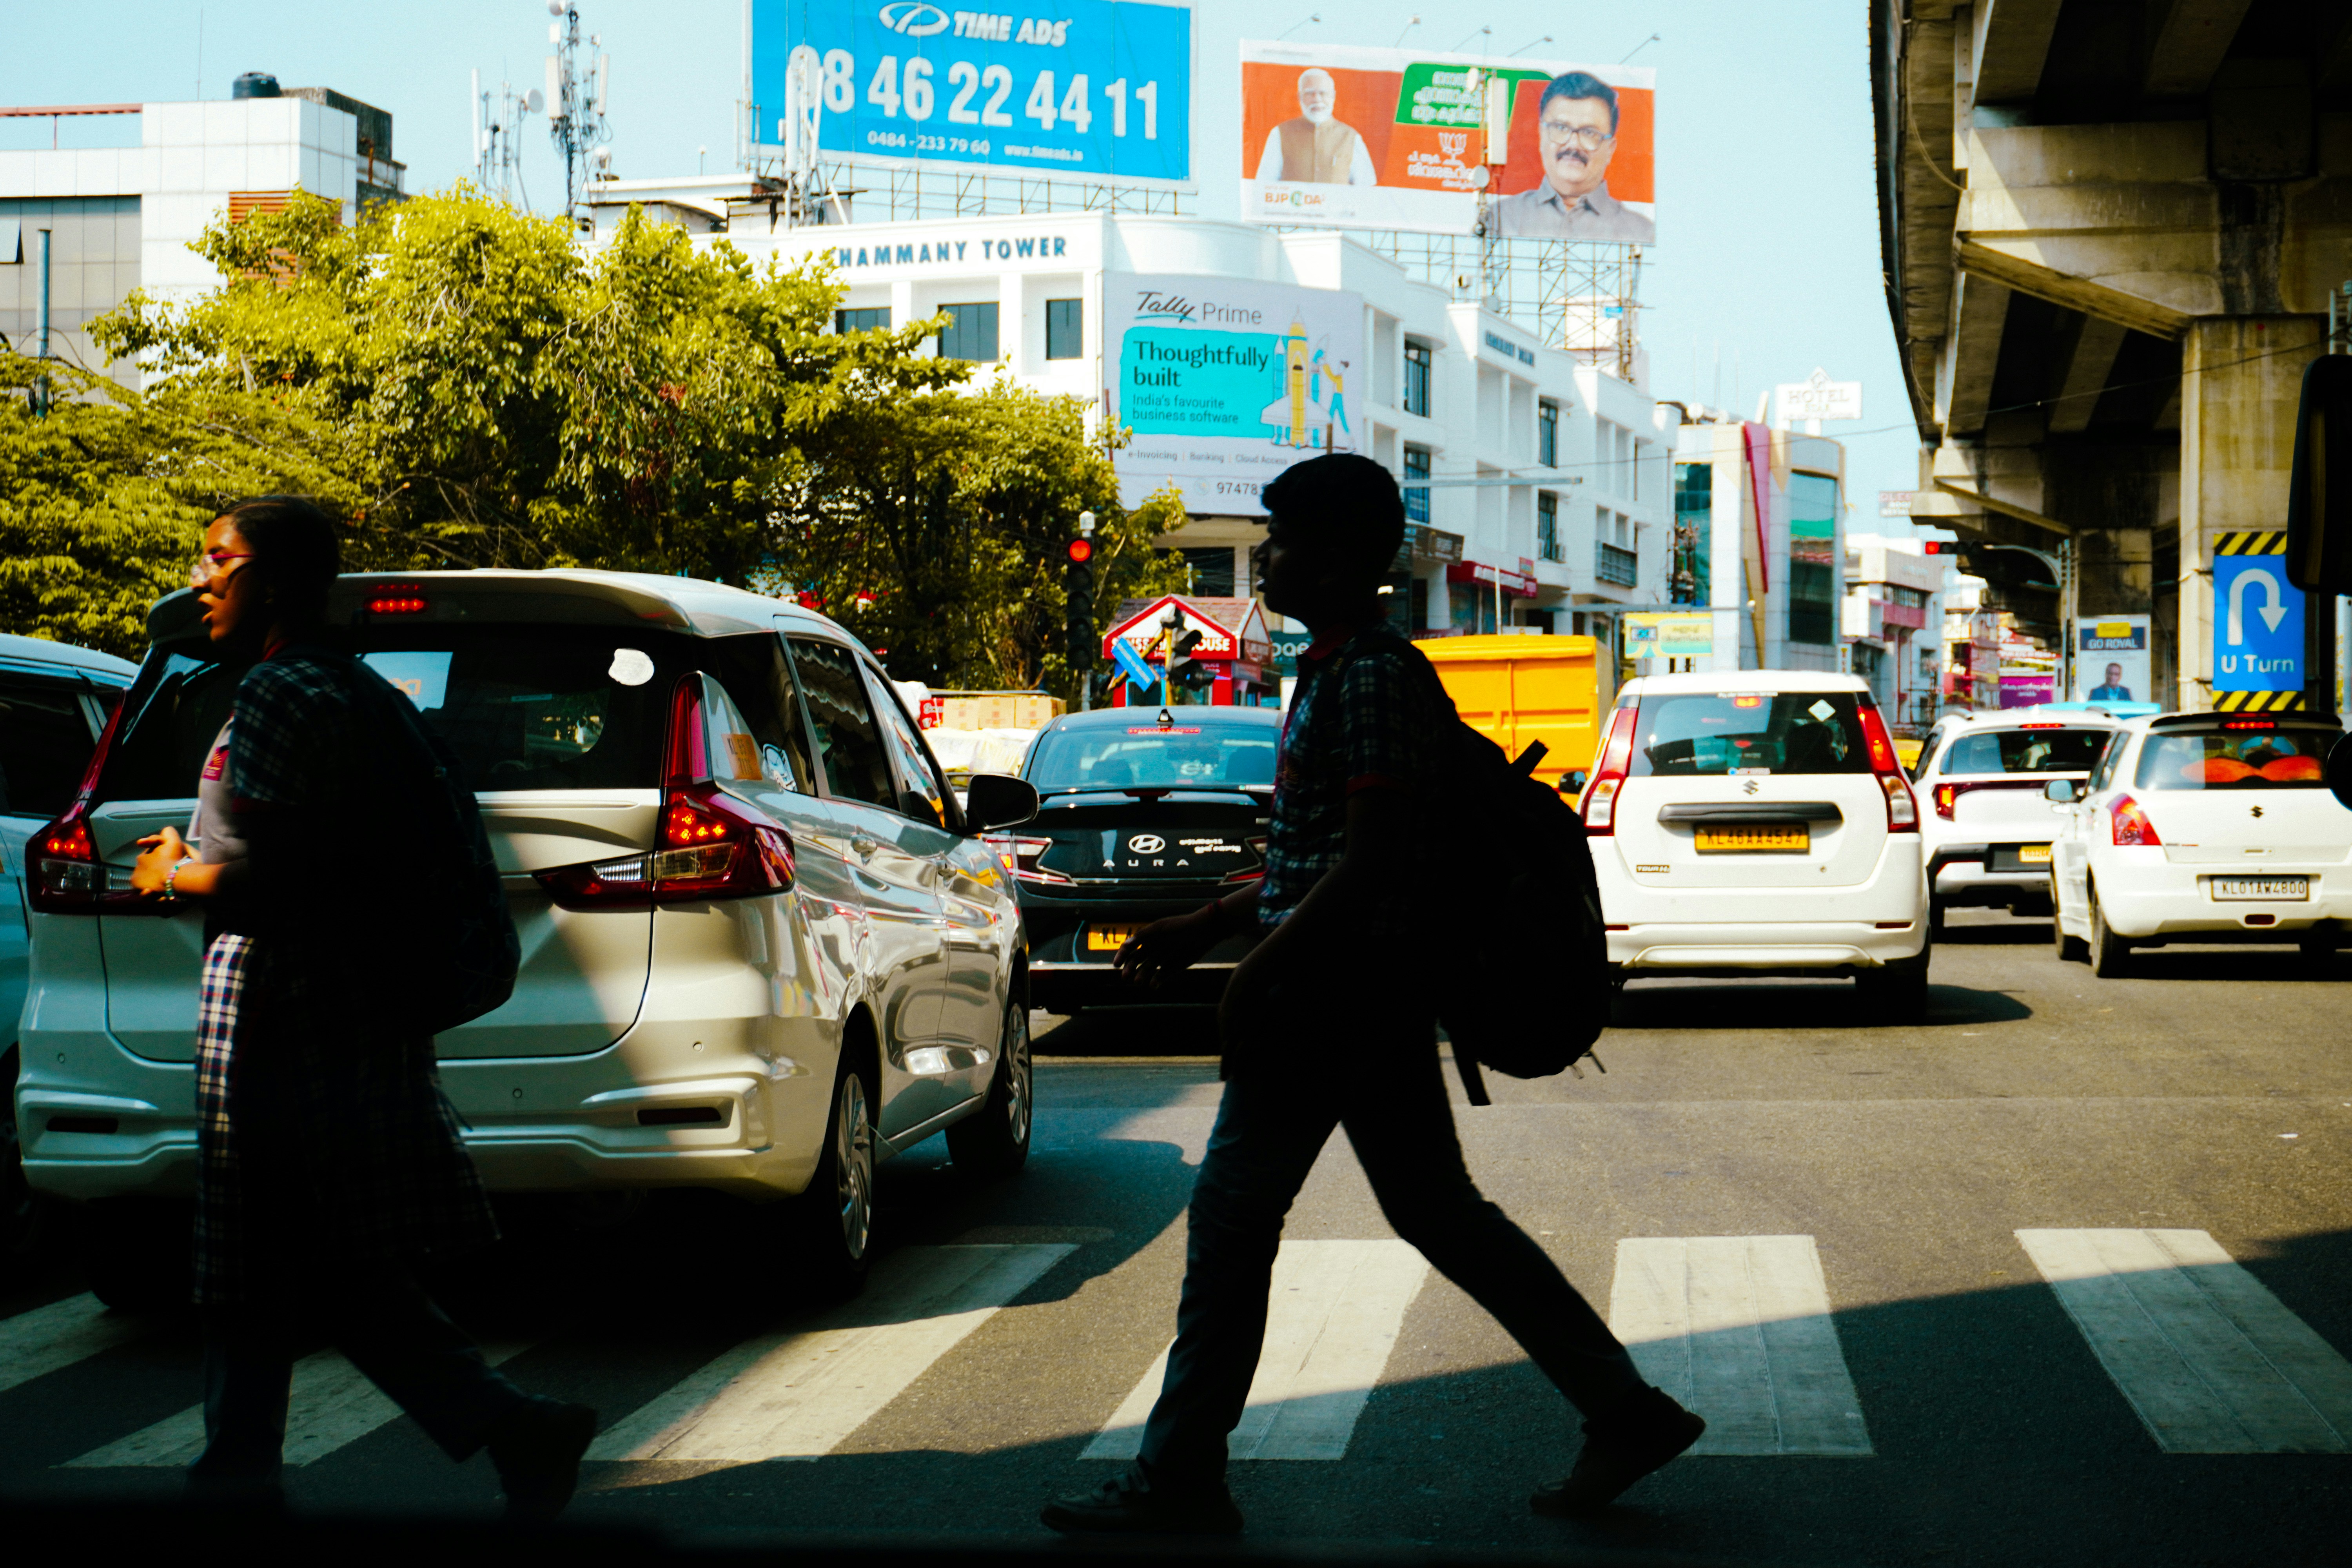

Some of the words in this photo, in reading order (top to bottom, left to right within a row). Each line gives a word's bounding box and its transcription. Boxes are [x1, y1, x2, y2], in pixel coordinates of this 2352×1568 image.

[954, 11, 1012, 43] TIME
[1017, 18, 1068, 48] ADS
[867, 55, 935, 121] 46
[948, 61, 1013, 127] 22
[1025, 70, 1092, 134] 44
[1105, 78, 1157, 140] 11
[867, 130, 906, 148] 0484
[917, 135, 946, 152] 233
[949, 137, 969, 153] 79
[970, 139, 991, 156] 60
[1265, 192, 1289, 203] BJP
[829, 240, 967, 267] HAMMANY
[982, 236, 1067, 260] TOWER
[1135, 291, 1197, 323] Tally
[1203, 302, 1262, 325] Prime
[1133, 341, 1269, 372] Thoughtfully
[1134, 367, 1182, 387] built
[1132, 393, 1172, 408] India's
[1174, 394, 1225, 409] favourite
[1132, 408, 1186, 422] business
[1189, 410, 1239, 424] software
[1128, 450, 1178, 461] e-Invoicing
[1190, 452, 1224, 463] Banking
[1235, 454, 1259, 463] Cloud
[1260, 455, 1288, 465] Access
[1192, 638, 1230, 652] OUSE
[2088, 638, 2104, 649] GO
[2105, 638, 2138, 649] ROYAL
[2221, 654, 2237, 673] U
[2243, 654, 2294, 673] Turn
